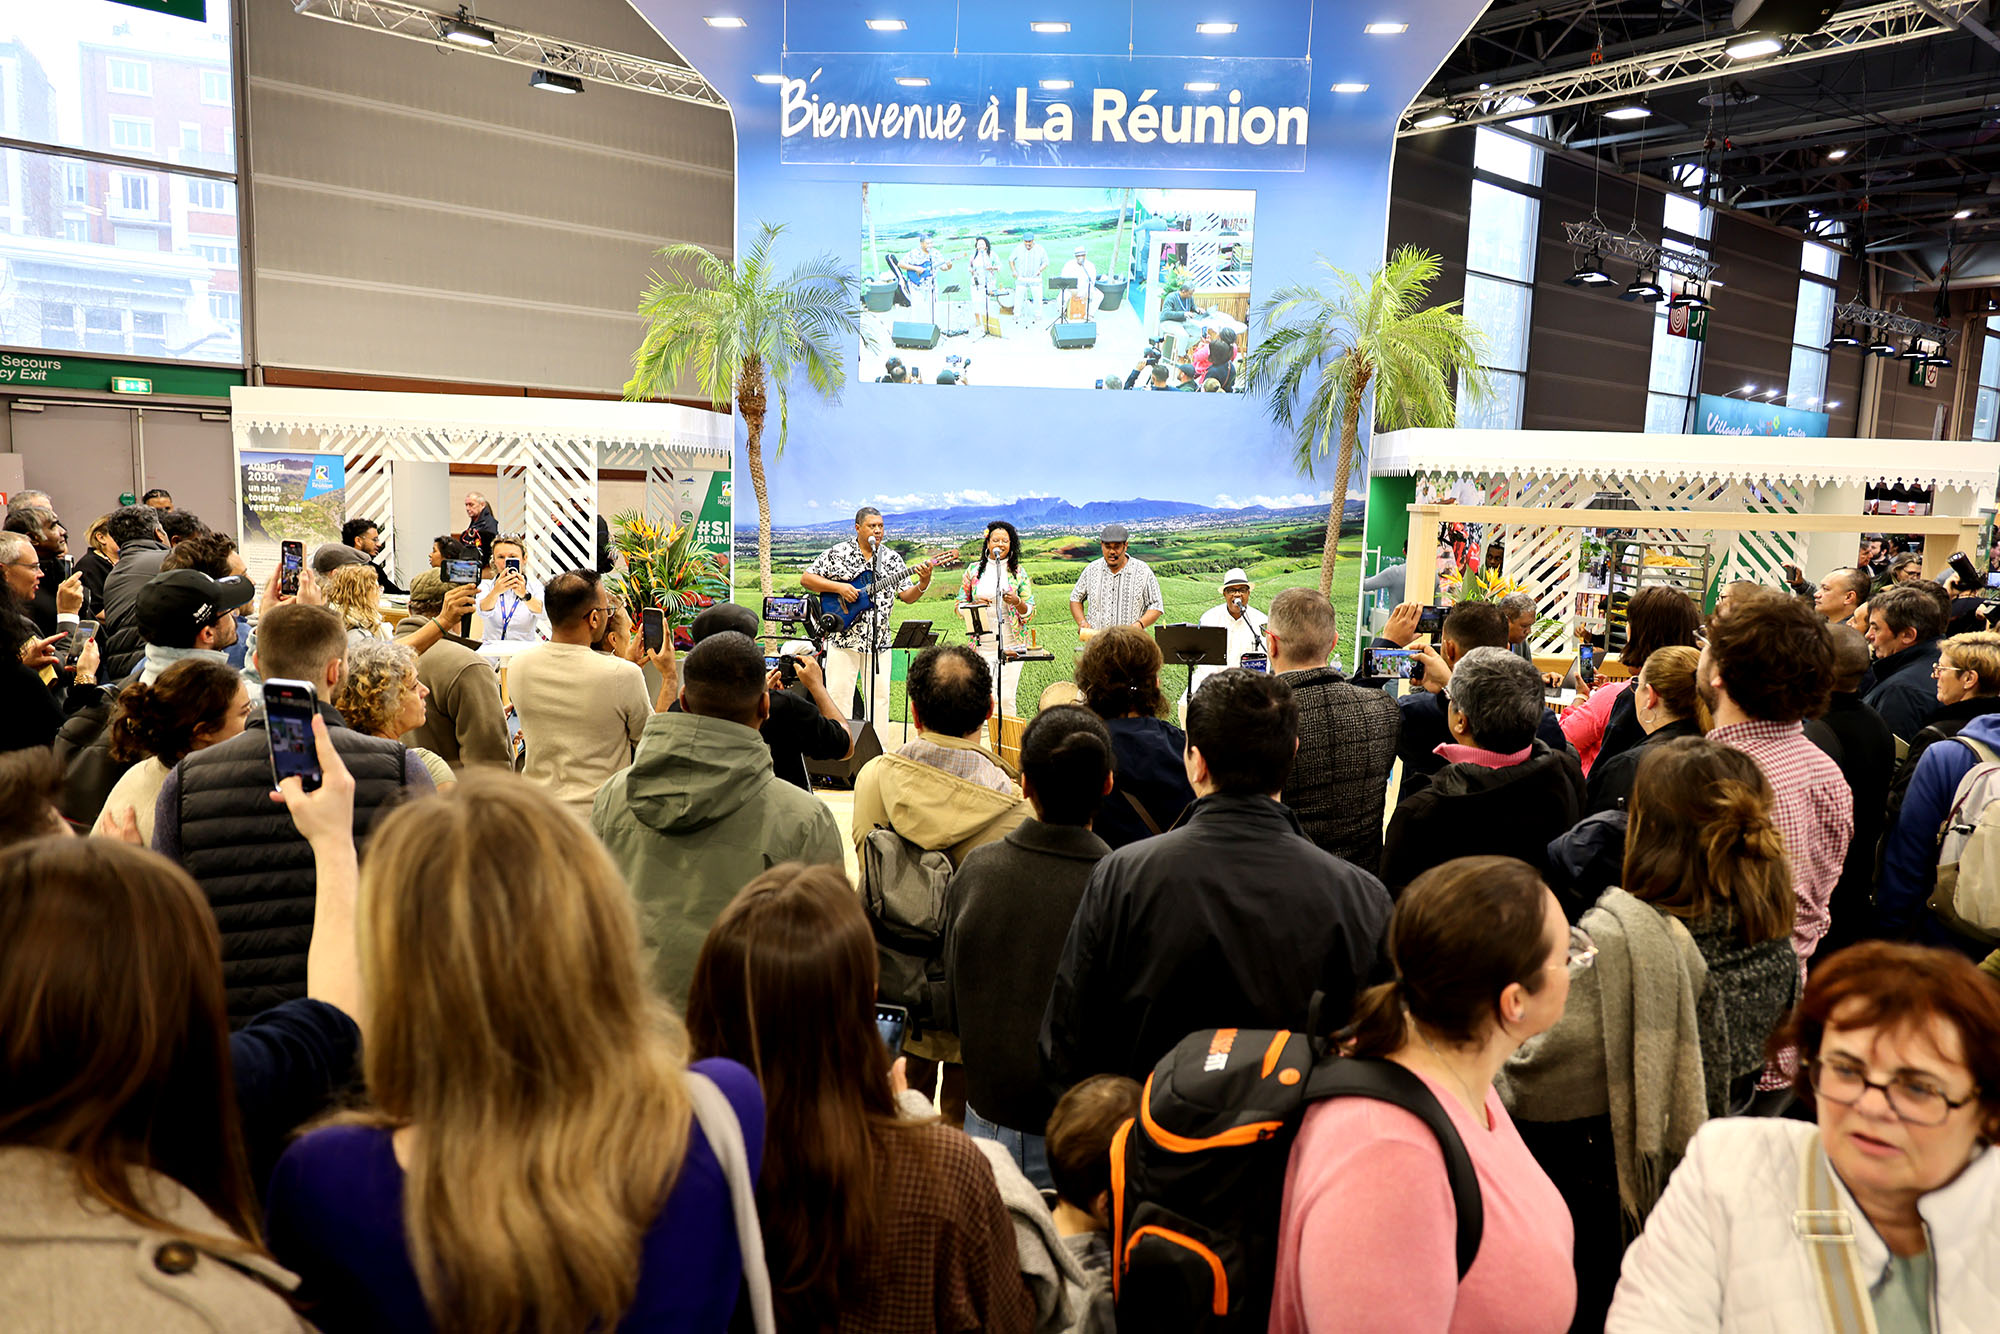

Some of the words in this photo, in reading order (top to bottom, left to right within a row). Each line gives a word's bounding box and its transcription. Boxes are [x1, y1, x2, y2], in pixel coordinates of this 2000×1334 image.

[780, 67, 966, 141] Bienvenue
[977, 94, 1005, 141] à
[1015, 87, 1073, 142] La
[1091, 88, 1308, 145] Réunion
[1, 355, 61, 370] Secours
[20, 368, 47, 381] Exit
[248, 471, 278, 483] 2030,
[261, 484, 281, 493] plan
[248, 493, 280, 502] tourné
[249, 504, 268, 512] vers
